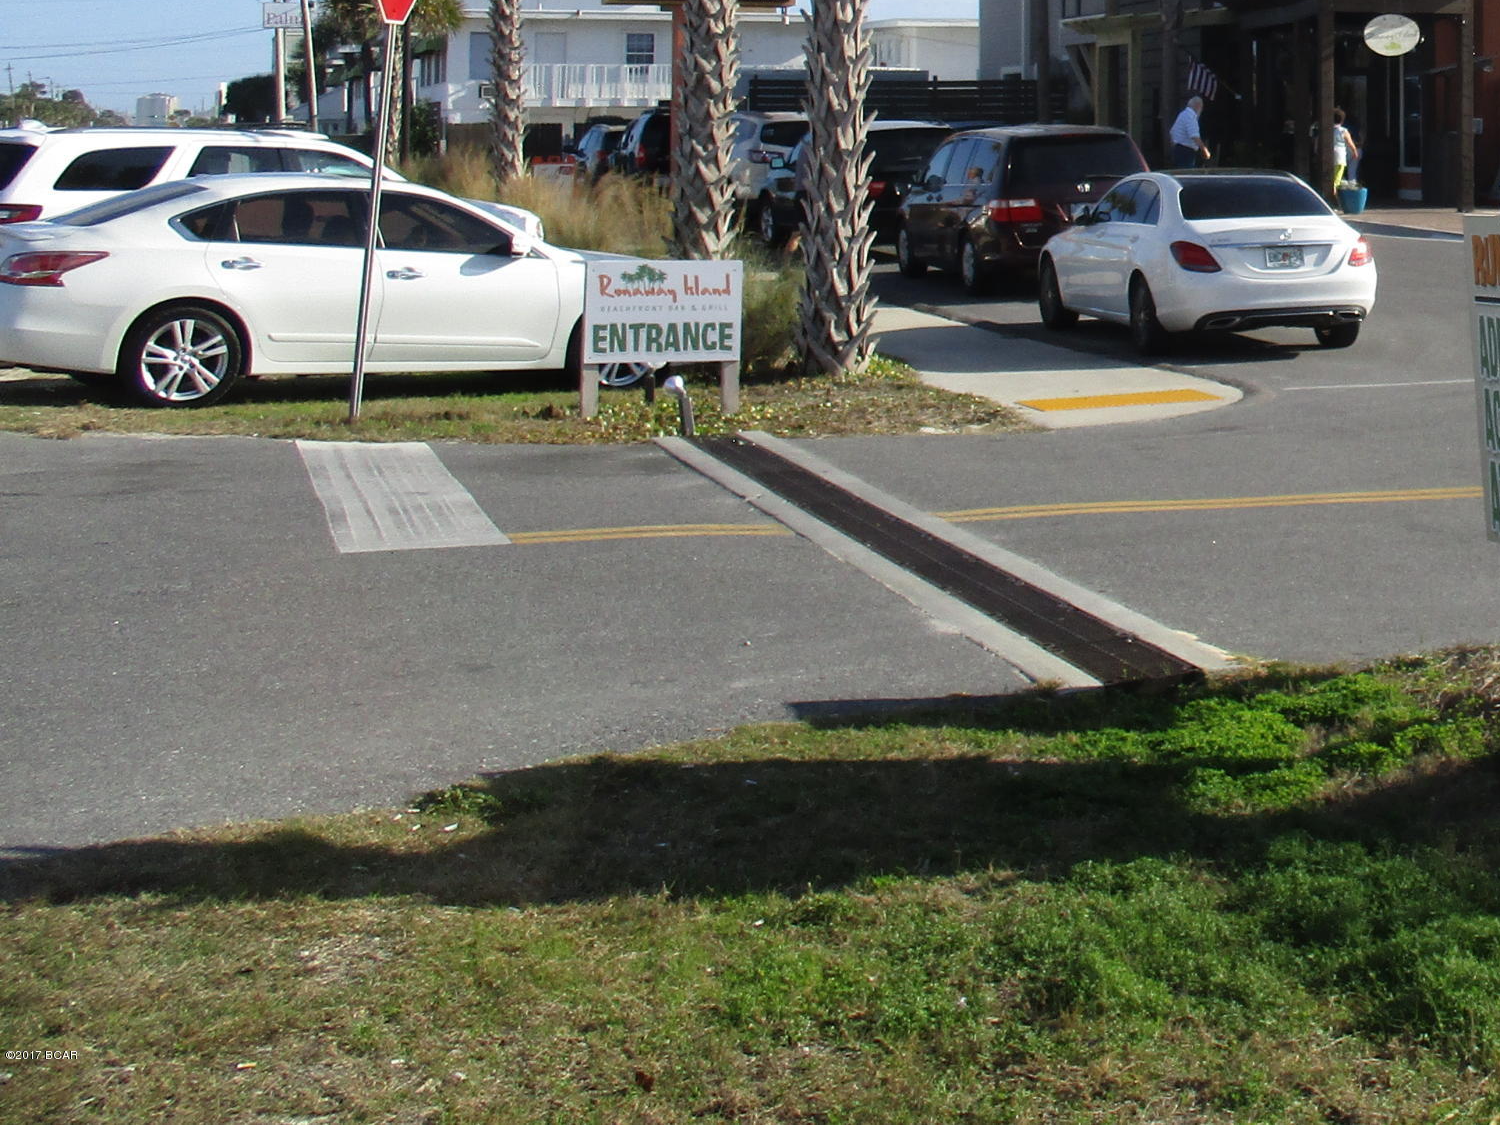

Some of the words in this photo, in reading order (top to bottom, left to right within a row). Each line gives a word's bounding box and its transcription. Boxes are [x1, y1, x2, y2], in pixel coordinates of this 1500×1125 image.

[598, 273, 677, 303] Runaway
[683, 273, 731, 296] Island
[592, 322, 734, 354] ENTRANCE
